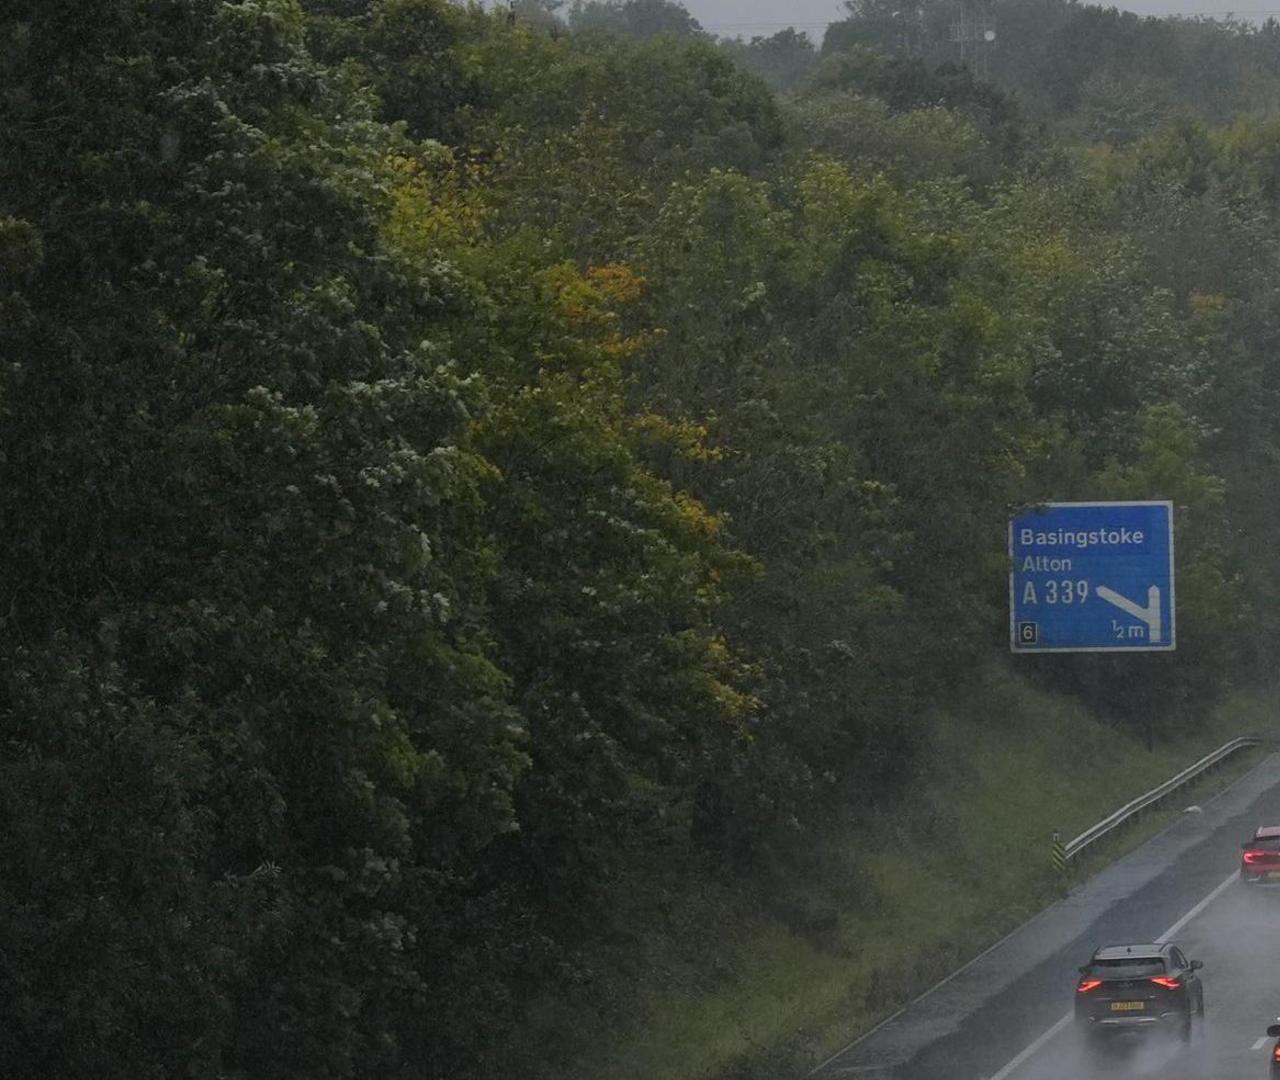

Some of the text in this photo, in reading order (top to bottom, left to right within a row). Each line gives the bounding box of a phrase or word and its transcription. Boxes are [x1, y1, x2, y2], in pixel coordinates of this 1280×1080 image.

[1021, 528, 1144, 548] Basingstoke
[1022, 556, 1072, 572] Alton
[1023, 625, 1033, 640] 6
[1128, 625, 1144, 638] m
